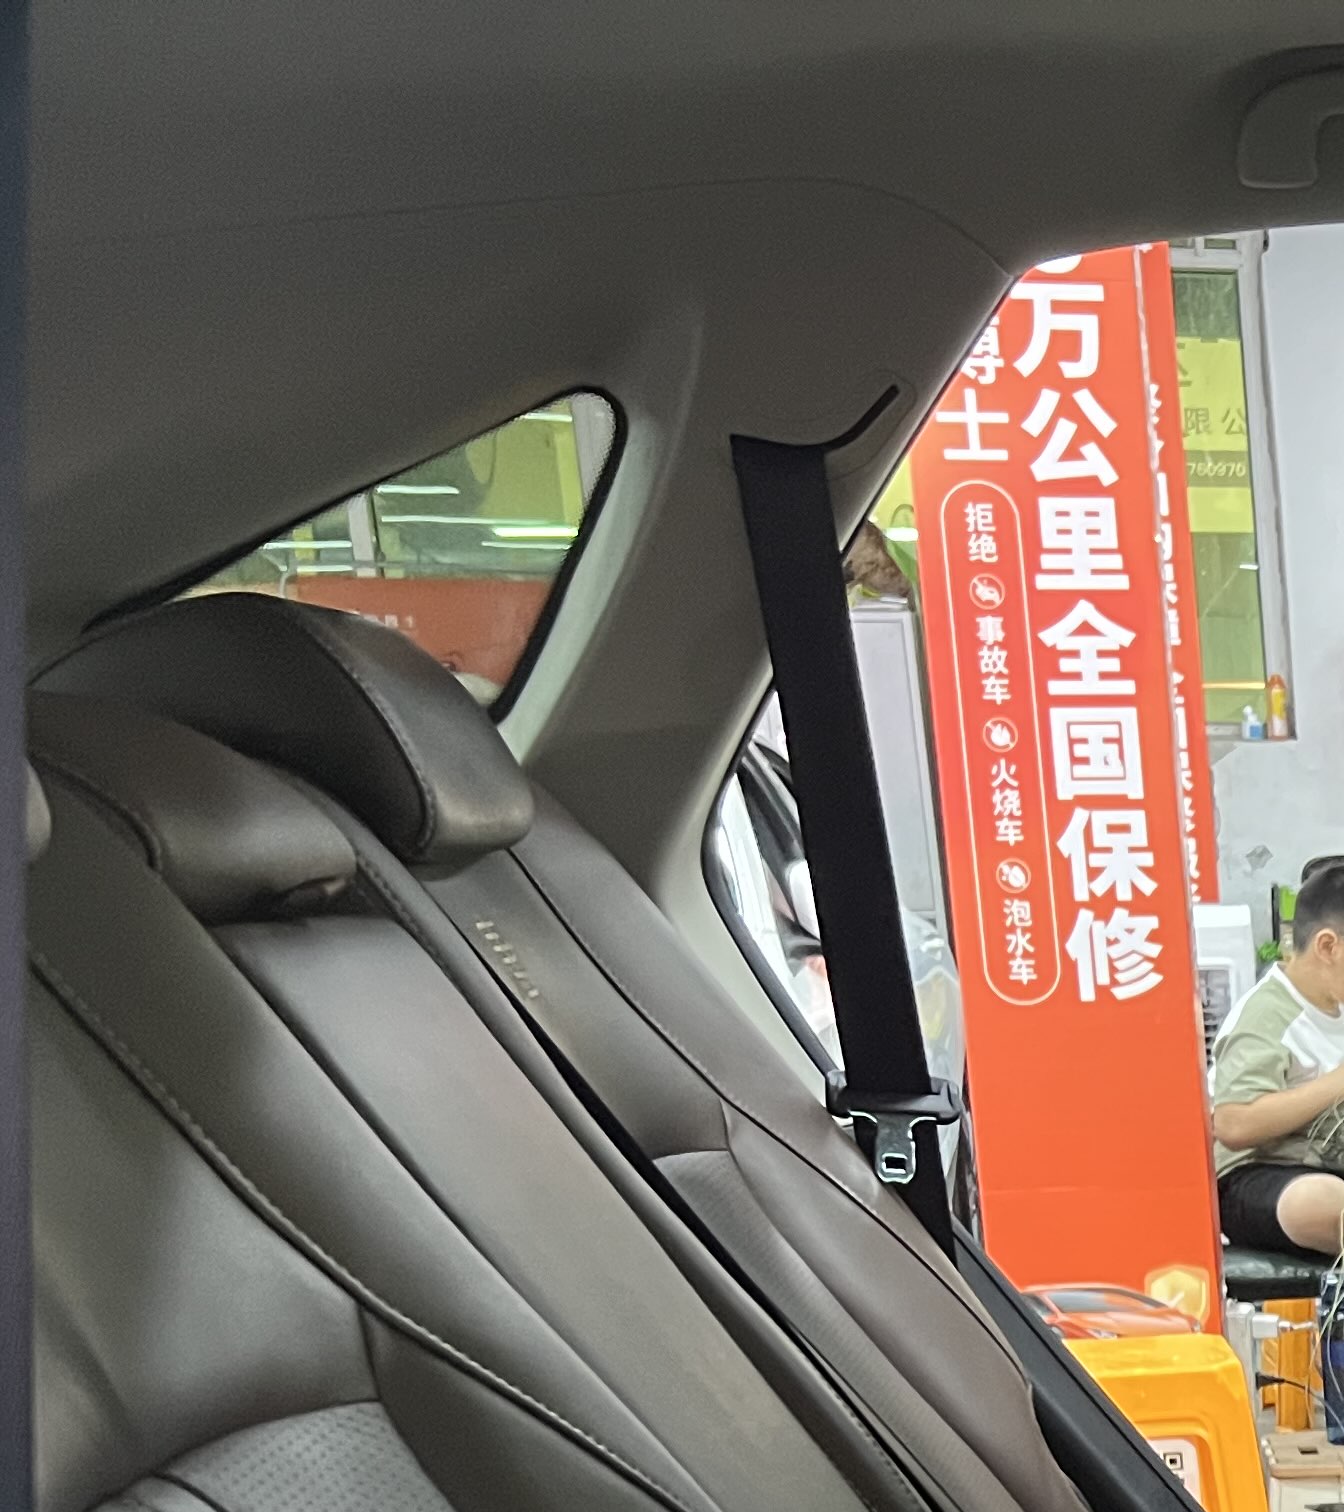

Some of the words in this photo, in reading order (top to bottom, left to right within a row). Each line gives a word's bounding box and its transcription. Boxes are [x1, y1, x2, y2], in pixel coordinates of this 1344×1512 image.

[964, 502, 999, 563] 拒绝
[976, 615, 1011, 705] 事故车
[1010, 255, 1164, 1002] 万公里全国保修
[990, 757, 1024, 846] 火烧车
[1003, 899, 1038, 986] 泡水车
